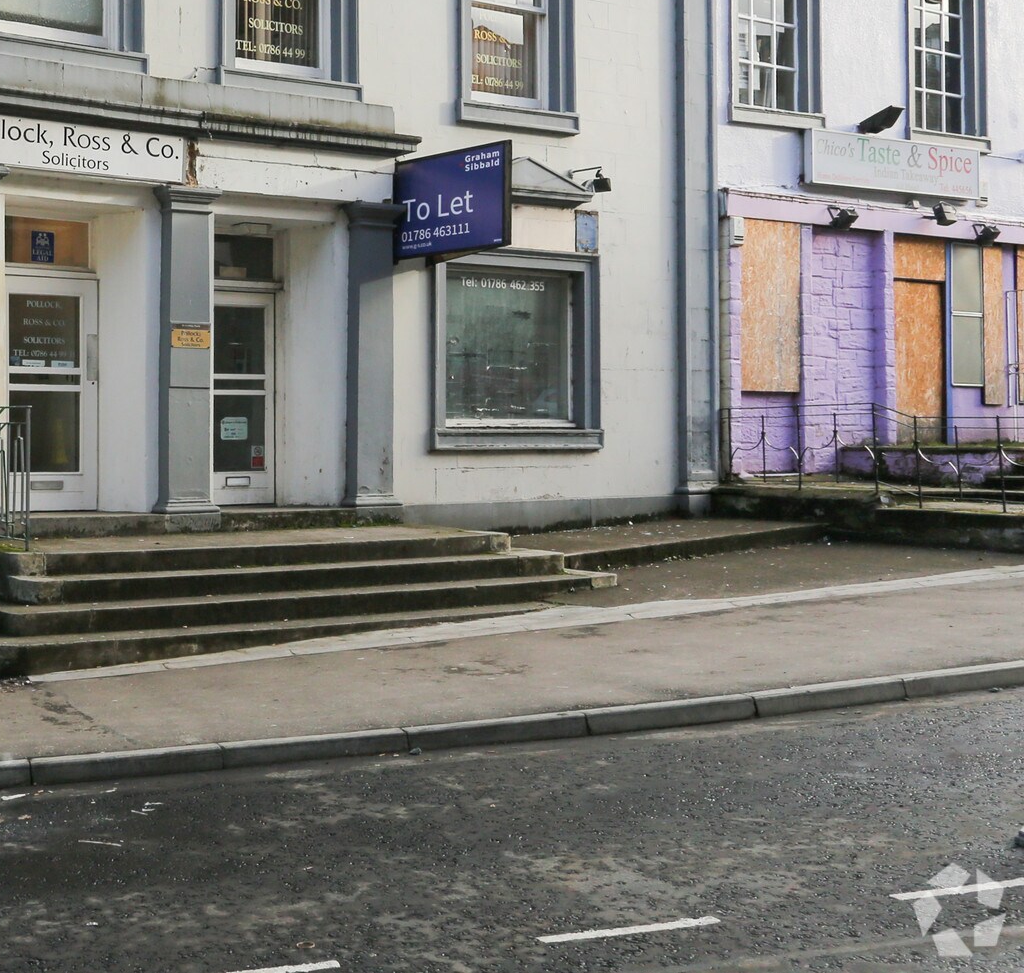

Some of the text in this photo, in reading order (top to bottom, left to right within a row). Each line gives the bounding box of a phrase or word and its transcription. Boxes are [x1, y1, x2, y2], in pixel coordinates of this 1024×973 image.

[248, 17, 304, 36] SOLICITORS
[474, 29, 497, 42] ROSS
[235, 39, 257, 52] TEL:
[258, 43, 281, 56] 01786
[282, 46, 293, 58] 44
[476, 53, 523, 69] SOLICITORS
[471, 74, 483, 85] EL:
[484, 76, 503, 88] 01786
[504, 79, 513, 90] 44
[63, 126, 111, 151] Ross
[121, 133, 138, 155] &
[146, 137, 179, 160] Co.
[42, 150, 109, 171] Solicitors
[464, 150, 500, 163] Graham
[816, 137, 972, 178] Chico's Taste & Spice
[464, 159, 500, 172] Sibbald
[402, 190, 473, 222] To Let
[401, 222, 470, 243] 01786 463111
[461, 276, 477, 287] Tel:
[481, 277, 507, 289] 01786
[23, 317, 43, 326] ROSS
[23, 336, 66, 345] SOLICITORS
[12, 348, 30, 357] TEL:
